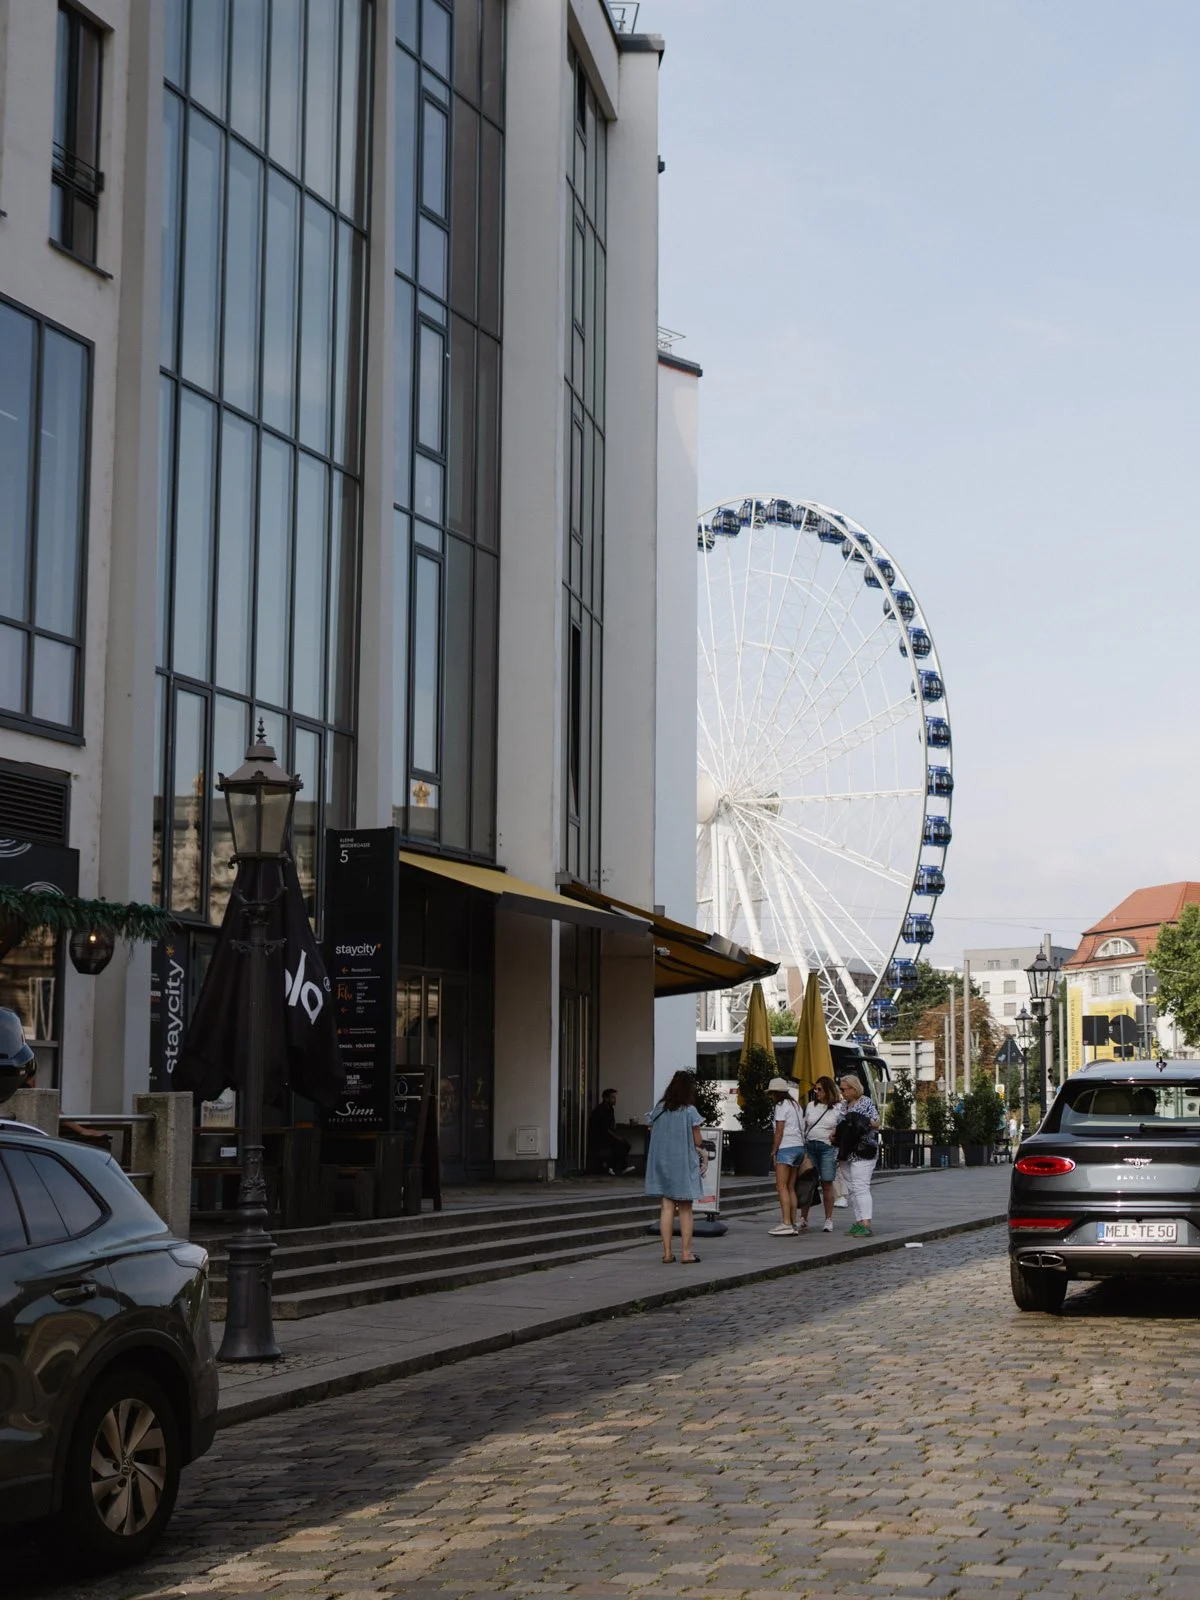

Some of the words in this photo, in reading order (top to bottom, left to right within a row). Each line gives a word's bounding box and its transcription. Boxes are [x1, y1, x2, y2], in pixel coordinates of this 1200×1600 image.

[339, 849, 349, 864] 5
[335, 943, 377, 957] staycity
[164, 958, 185, 1074] staycity
[335, 1101, 374, 1116] Sinn
[1105, 1225, 1129, 1238] MEI
[1139, 1225, 1155, 1238] TE
[1158, 1225, 1174, 1238] 50
